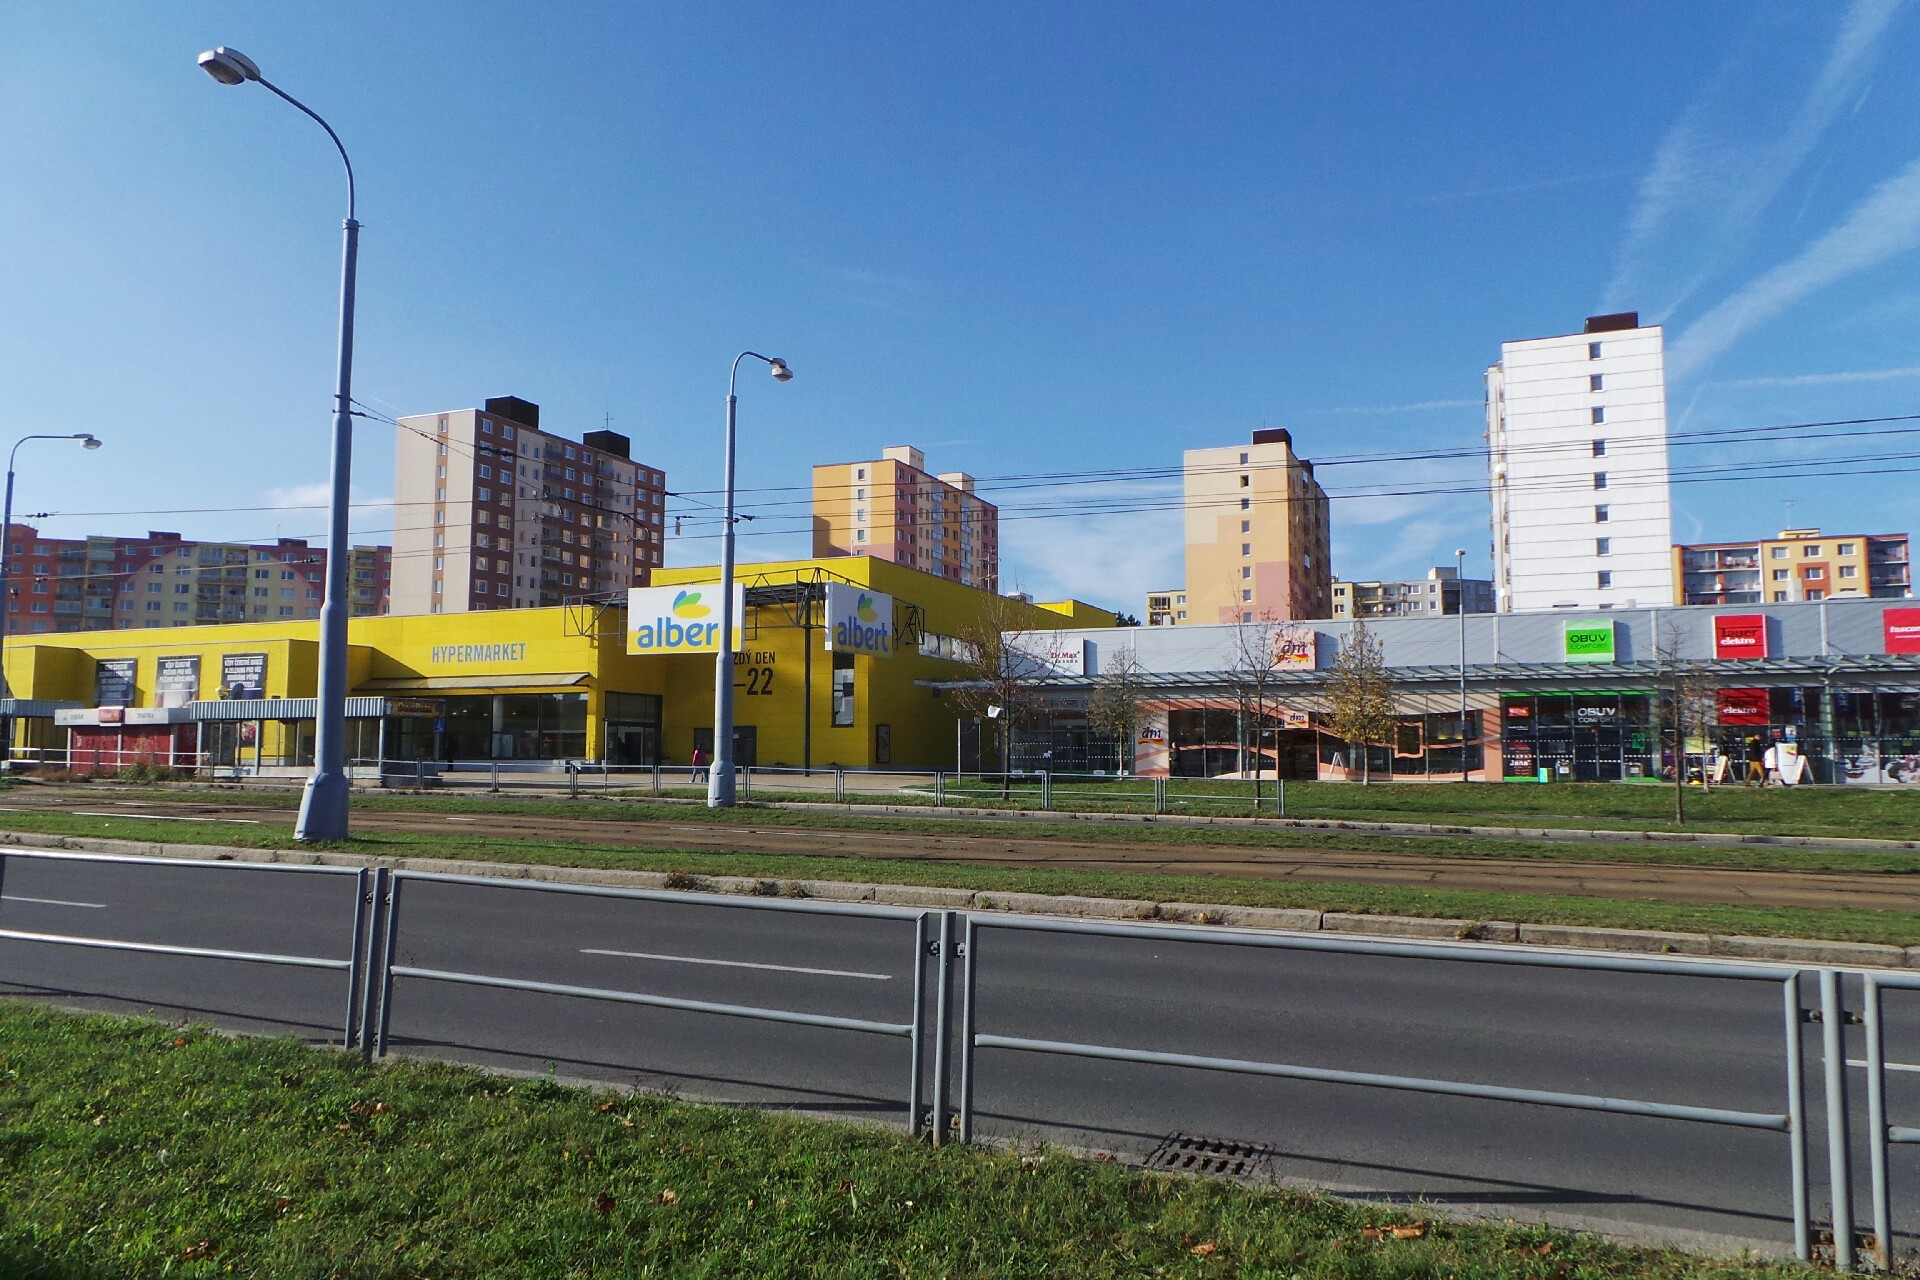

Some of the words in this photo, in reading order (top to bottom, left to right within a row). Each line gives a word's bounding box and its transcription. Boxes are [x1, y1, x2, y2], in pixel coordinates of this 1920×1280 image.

[637, 616, 720, 648] alber
[838, 615, 888, 653] albert
[1570, 634, 1607, 643] OBUV
[1720, 637, 1756, 645] elektro
[432, 643, 526, 663] HYPERMARKET
[1281, 640, 1306, 654] dm
[755, 651, 776, 664] DEN
[1290, 713, 1304, 721] dm
[1577, 707, 1616, 716] OBUV
[1142, 726, 1161, 738] dm
